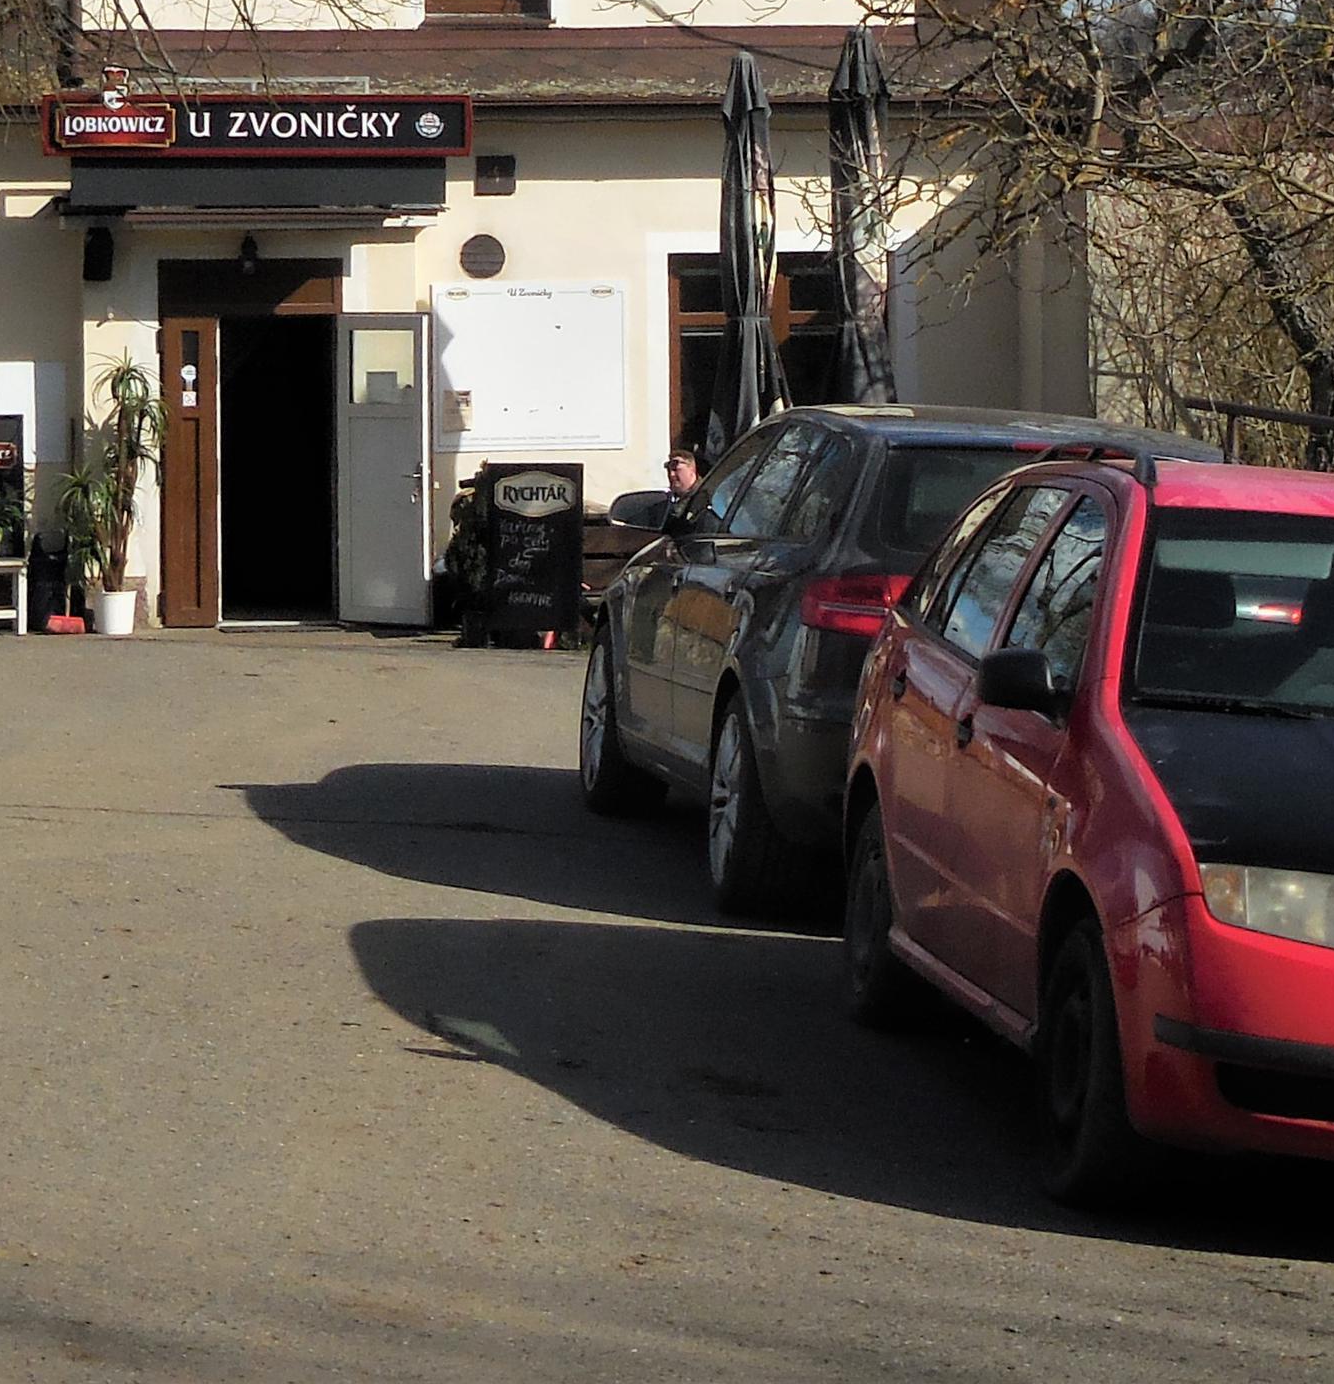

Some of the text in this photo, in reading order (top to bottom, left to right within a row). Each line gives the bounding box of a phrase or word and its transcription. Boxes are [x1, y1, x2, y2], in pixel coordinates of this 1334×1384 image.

[65, 116, 165, 136] LOBKOWICZ
[189, 104, 401, 138] U ZVONIČKY
[503, 483, 571, 505] RYCHTÁŘ
